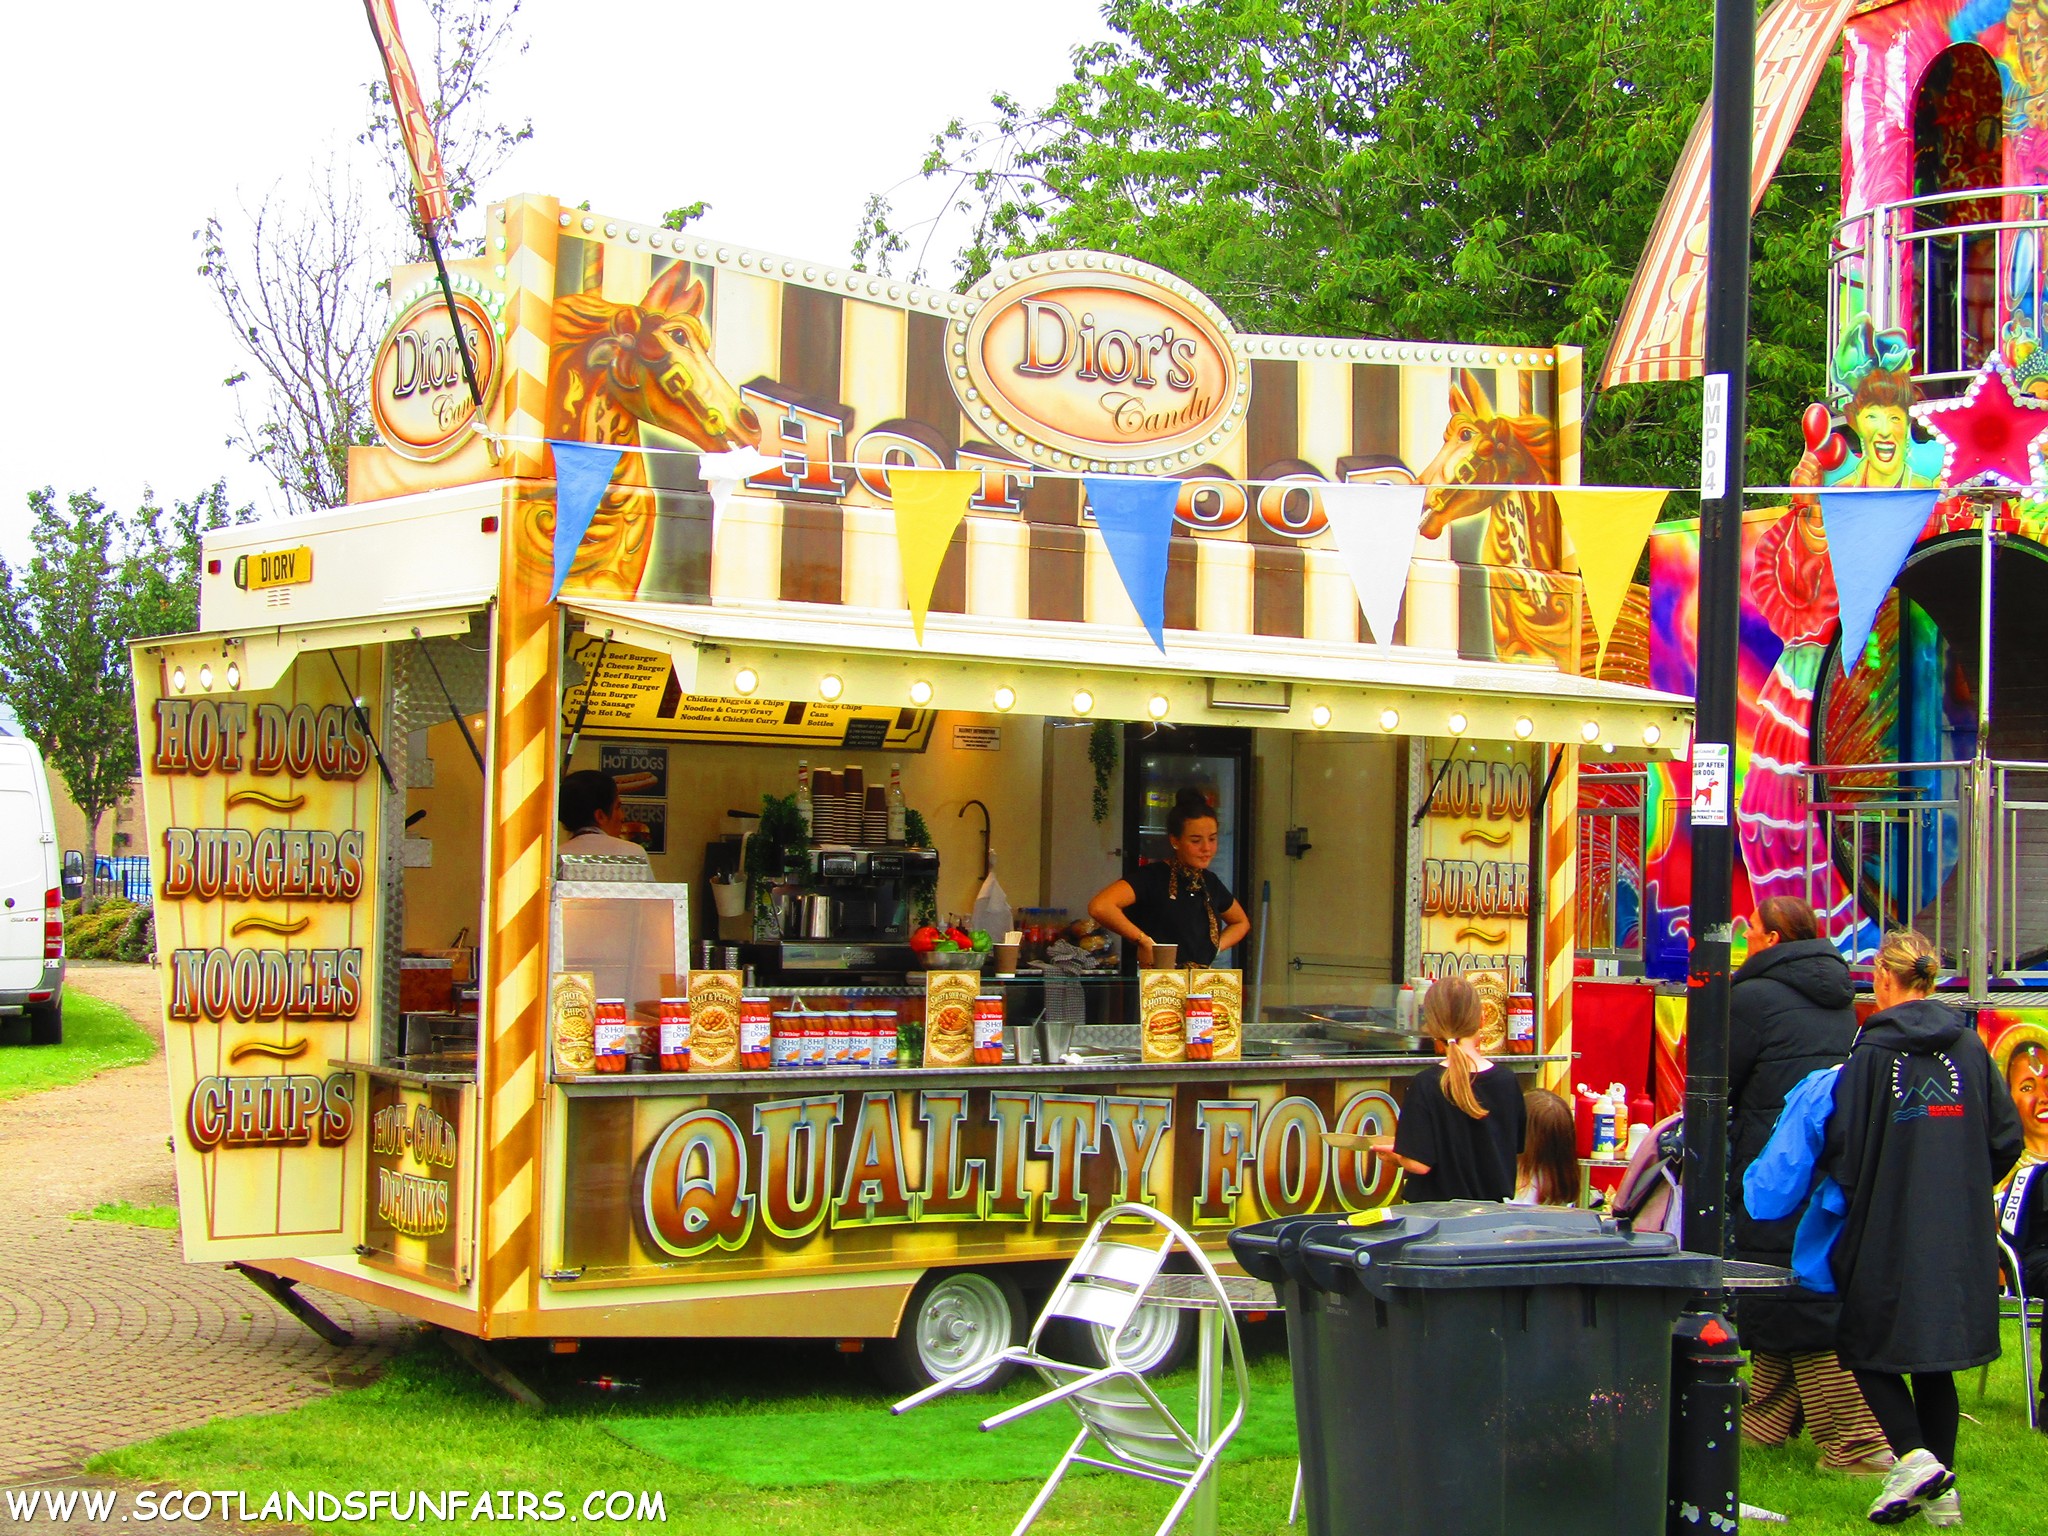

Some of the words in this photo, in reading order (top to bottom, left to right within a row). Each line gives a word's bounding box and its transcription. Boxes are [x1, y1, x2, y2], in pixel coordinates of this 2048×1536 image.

[1019, 299, 1197, 389] Dior's
[1099, 387, 1210, 435] Candy
[1705, 383, 1721, 490] MMP04
[740, 384, 1034, 513] HOT
[629, 654, 657, 662] Burger
[606, 662, 635, 670] Cheese
[637, 664, 666, 672] Burger
[623, 673, 652, 681] Burger
[573, 689, 606, 697] Chiken
[609, 690, 638, 699] Burger
[631, 683, 660, 691] Burger
[601, 700, 635, 708] Sausage
[720, 697, 752, 705] Nuggets
[762, 700, 784, 708] Chips
[568, 708, 596, 716] Jubo
[616, 710, 632, 718] Dog
[722, 715, 754, 723] Chicken
[157, 699, 247, 771] HOT
[257, 703, 370, 776] DOGS
[603, 755, 627, 769] HOT
[631, 757, 664, 770] DOGS
[1431, 759, 1487, 814] HOT
[1493, 762, 1531, 818] DO
[624, 805, 664, 823] RGERS
[166, 827, 364, 898] BURGERS
[1425, 858, 1529, 915] BURGER
[173, 947, 362, 1018] NOODLES
[563, 992, 580, 1000] HOT
[691, 994, 708, 1009] SALT
[714, 992, 737, 1006] PEPPER
[1153, 989, 1176, 997] JUMBO
[562, 1008, 586, 1017] CHIPS
[1933, 1051, 1959, 1095] ENTURE
[192, 1073, 355, 1145] CHIPS
[644, 1090, 1172, 1257] QUALITY
[1193, 1089, 1405, 1225] FOO
[379, 1167, 448, 1236] DRINKS
